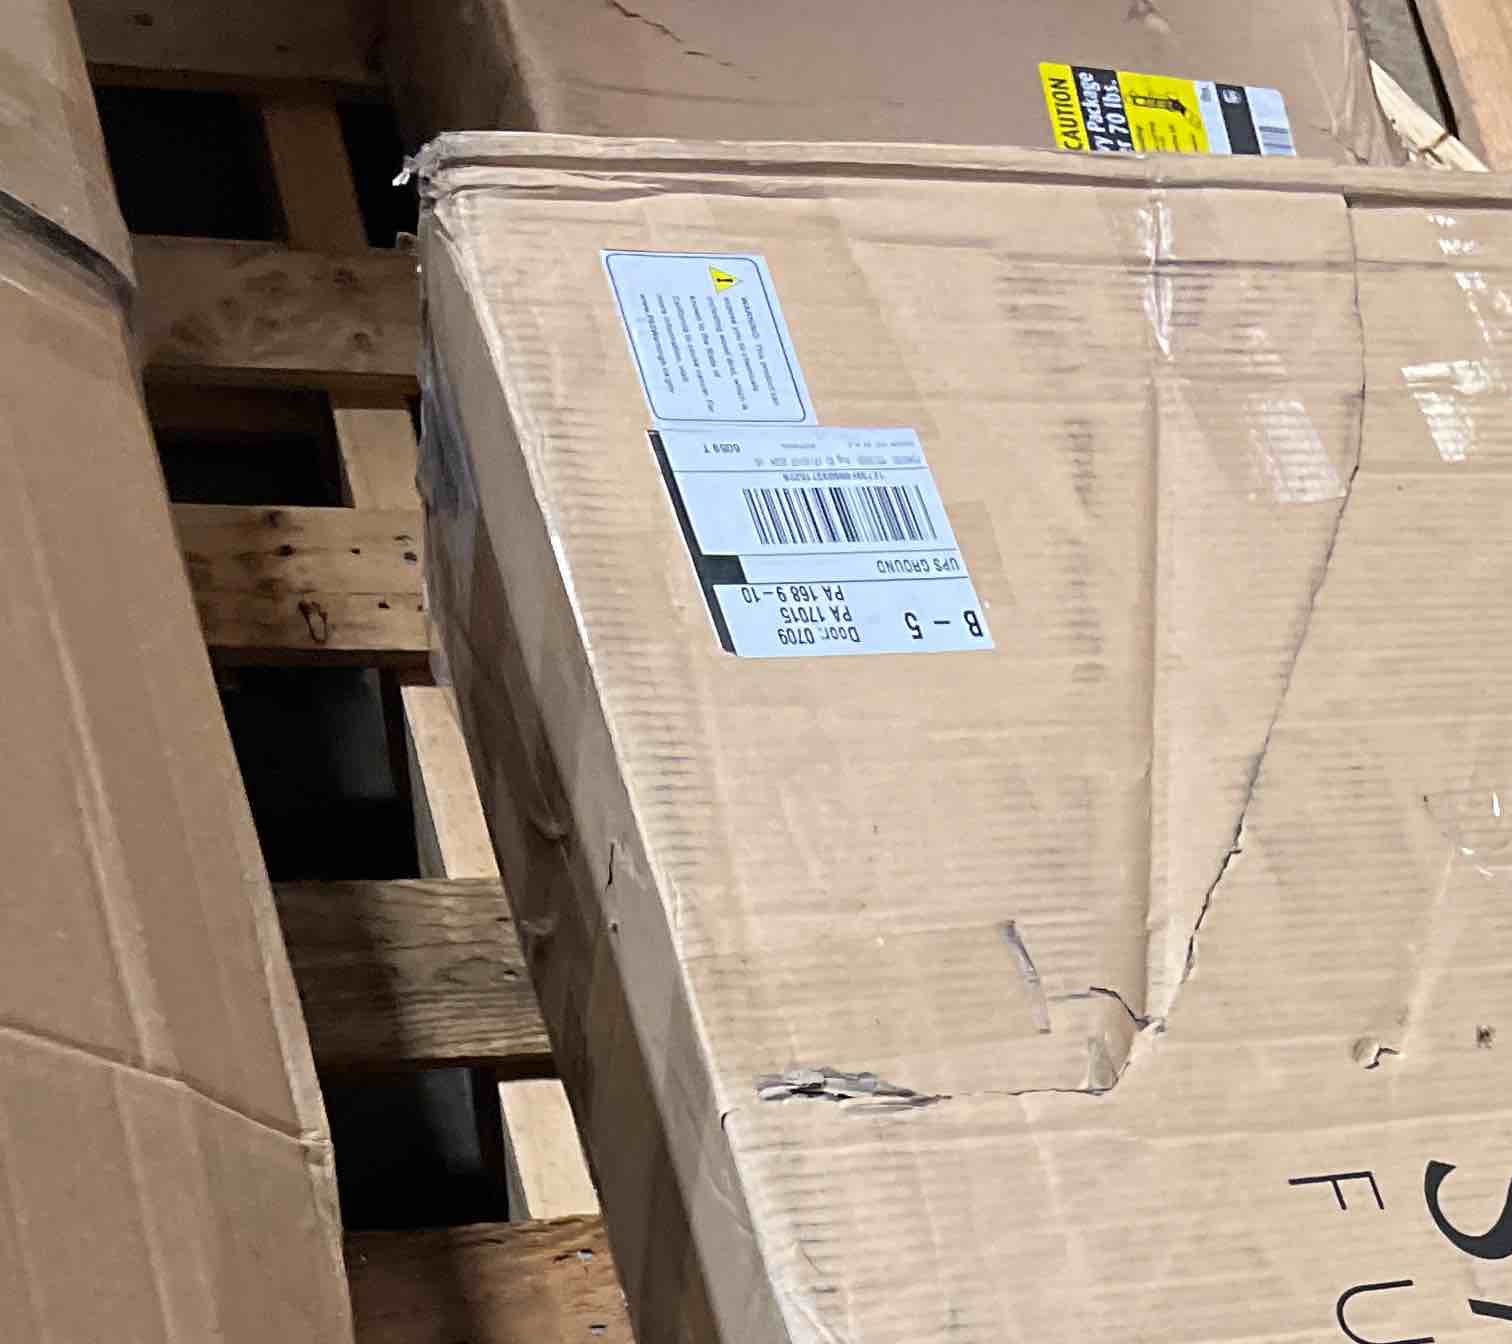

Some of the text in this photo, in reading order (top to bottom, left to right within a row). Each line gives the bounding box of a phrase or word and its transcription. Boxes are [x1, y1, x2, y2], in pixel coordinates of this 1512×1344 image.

[1079, 72, 1105, 132] Package
[1103, 80, 1123, 112] lbs.
[1050, 78, 1083, 151] CAUTION
[1108, 113, 1127, 135] 70
[877, 558, 960, 574] UPS GROUND
[791, 585, 818, 602] 168
[824, 585, 844, 601] PA
[780, 607, 851, 624] PA 17015
[904, 611, 923, 639] 5
[963, 609, 984, 637] B
[778, 626, 861, 645] Door: 0709
